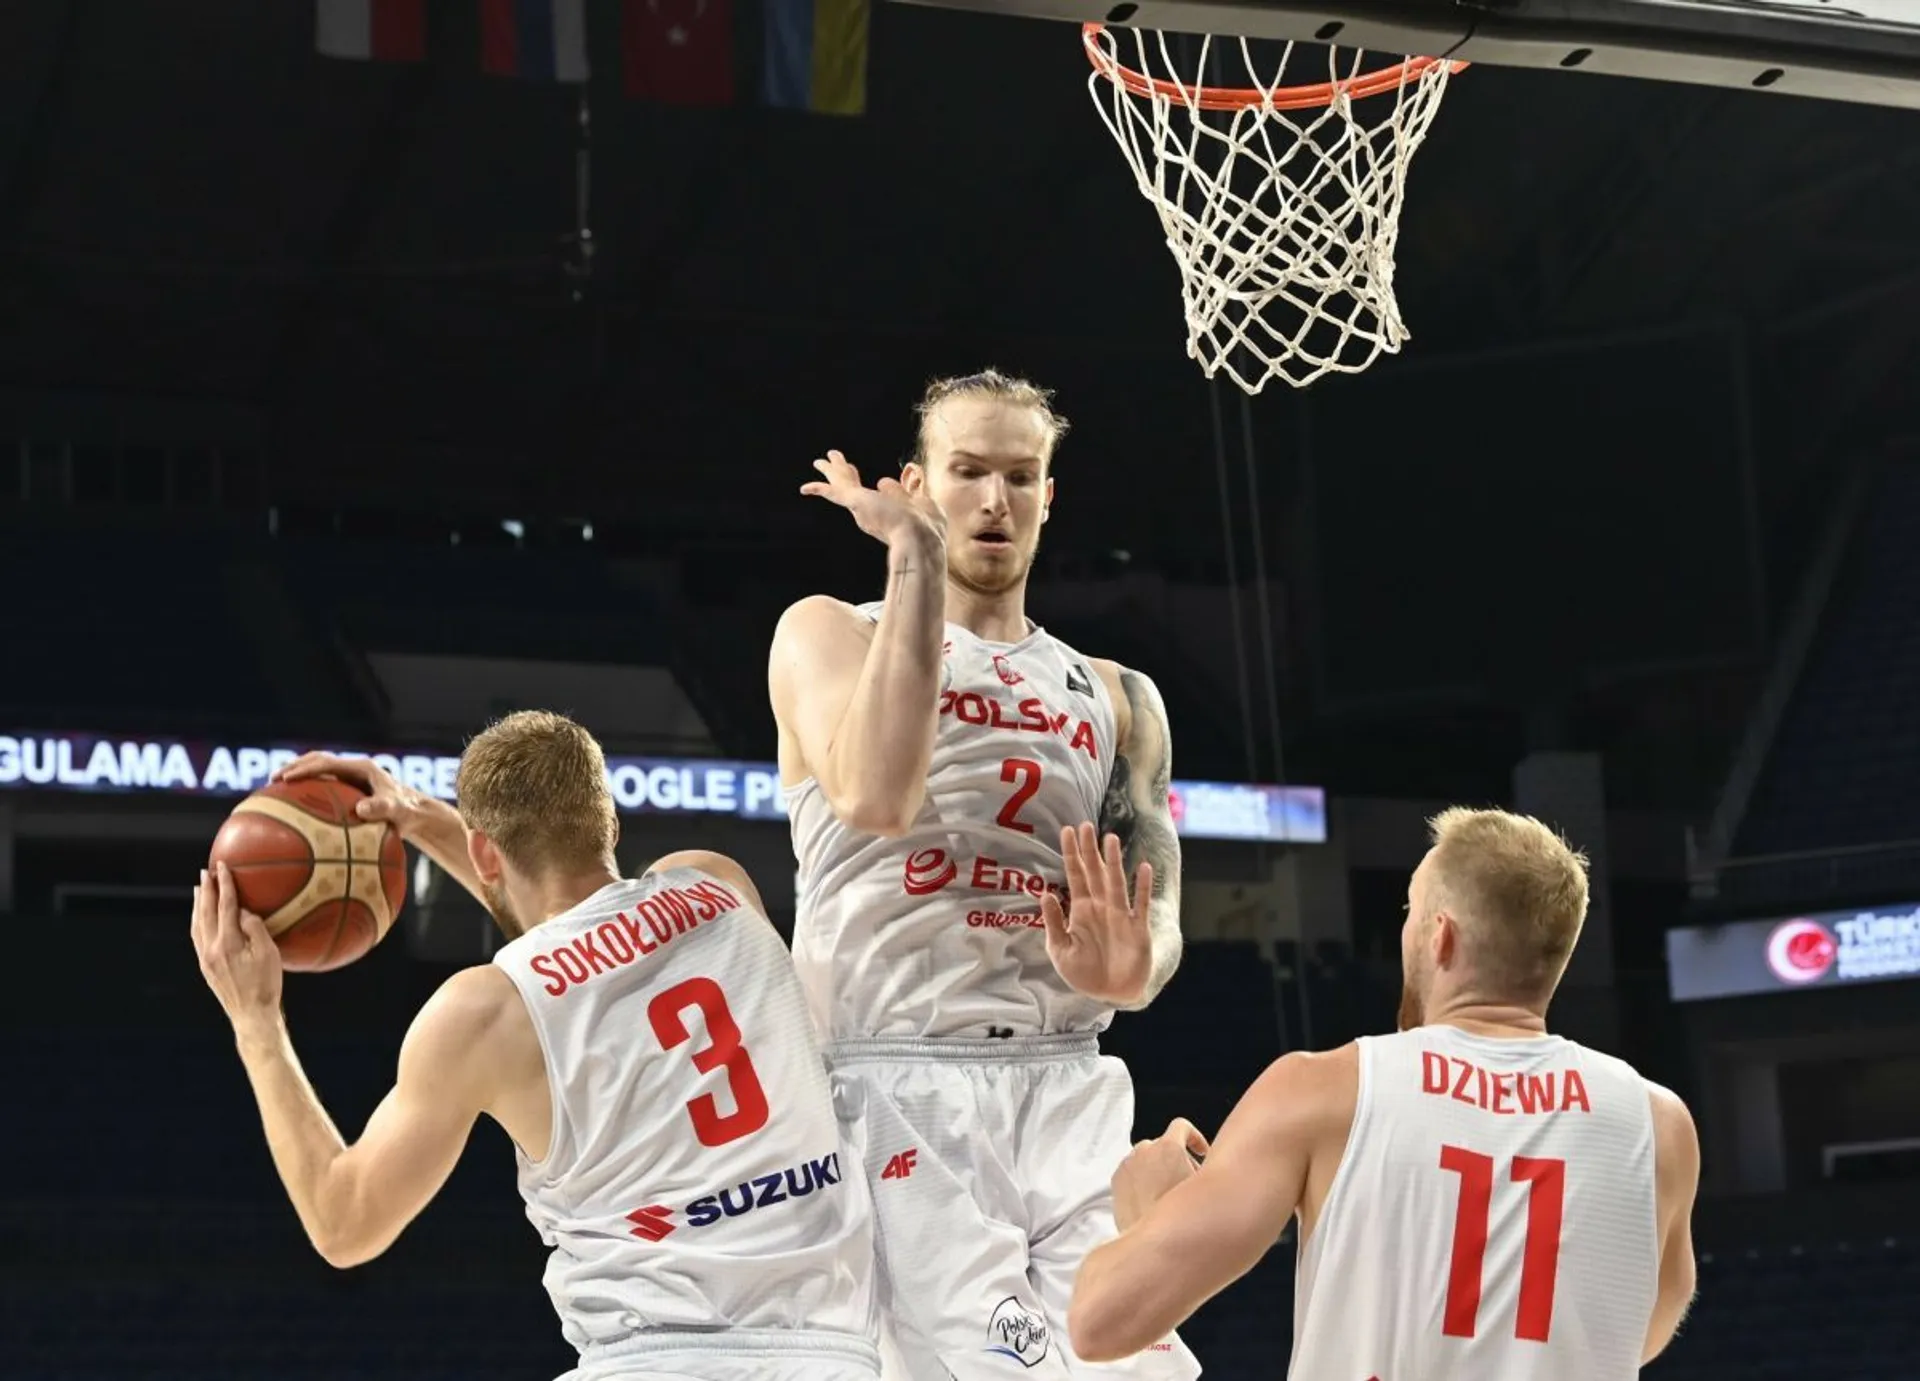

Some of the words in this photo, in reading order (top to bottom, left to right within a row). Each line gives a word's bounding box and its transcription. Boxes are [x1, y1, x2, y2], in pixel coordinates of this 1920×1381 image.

[606, 764, 737, 811] OGLE
[995, 757, 1042, 834] 2
[530, 880, 742, 997] SOKOŁOWSKI
[647, 976, 770, 1147] 3
[1422, 1050, 1591, 1115] DZIEWA
[684, 1151, 842, 1227] SUZUKI
[1439, 1143, 1566, 1344] 11
